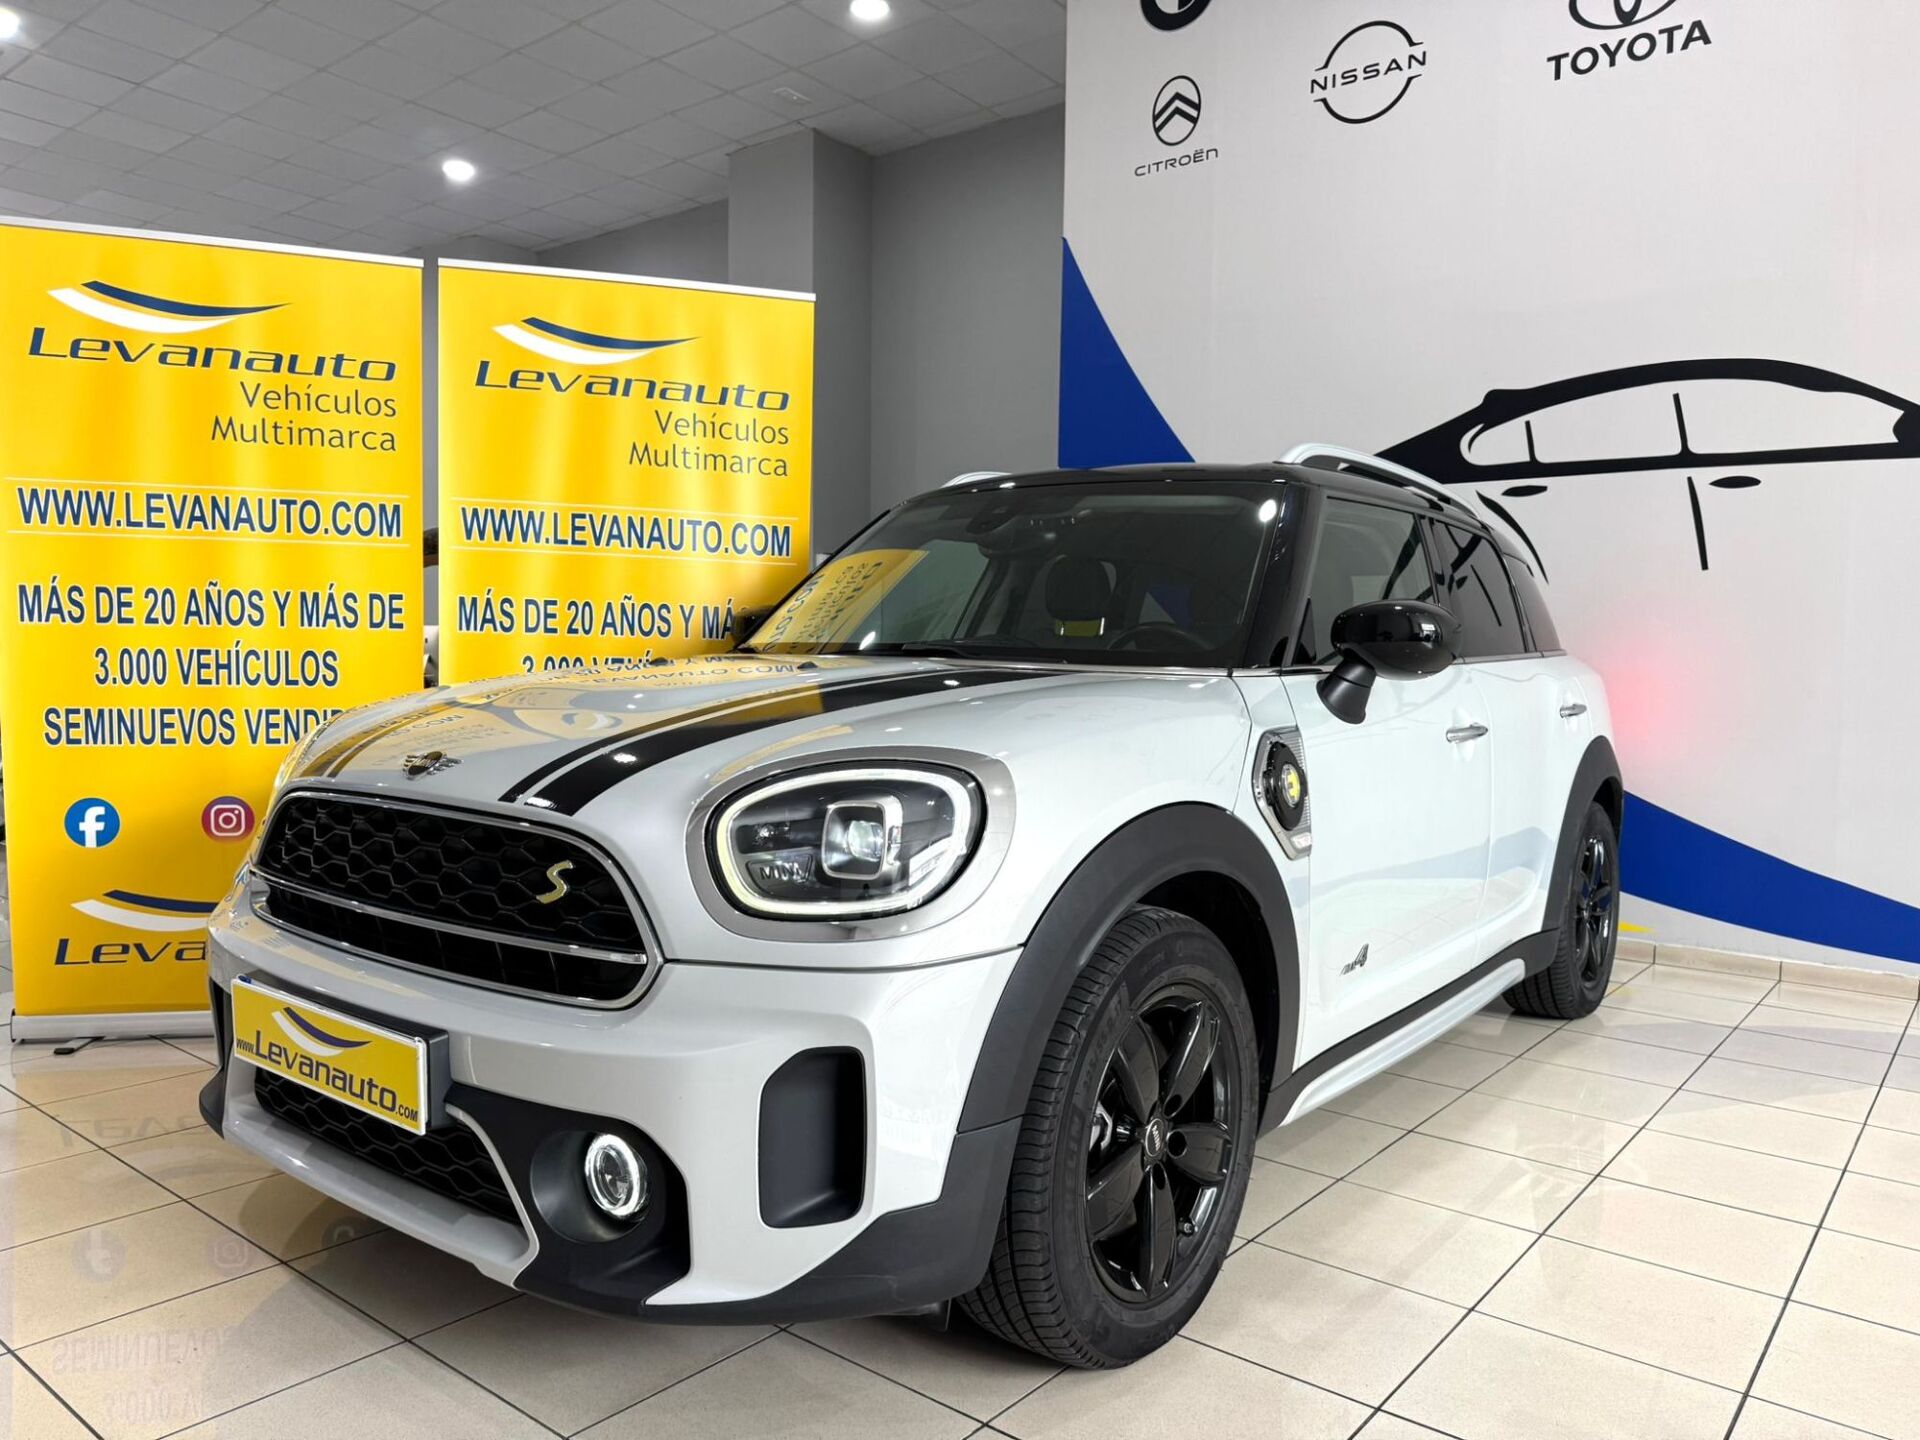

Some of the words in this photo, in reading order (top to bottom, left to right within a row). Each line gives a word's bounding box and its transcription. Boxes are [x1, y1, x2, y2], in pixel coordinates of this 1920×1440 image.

[1310, 50, 1427, 95] NISSAN
[1546, 18, 1712, 81] TOYOTA
[1134, 147, 1219, 177] CITROËN
[28, 327, 397, 381] Levanauto
[240, 381, 397, 418] Vehículos
[475, 360, 790, 411] Levanauto
[211, 415, 397, 452] Multimarca
[655, 410, 789, 445] Vehículos
[629, 441, 789, 477] Multimarca
[17, 487, 402, 538] WWW.LEVANAUTO.COM
[461, 507, 791, 556] WWW.LEVANAUTO.COM
[18, 575, 85, 624] MÁS
[95, 586, 134, 624] DE
[144, 587, 176, 625] 20
[184, 581, 264, 627] AÑOS
[272, 590, 292, 627] Y
[300, 583, 359, 629] MÁS
[369, 593, 404, 629] DE
[458, 588, 515, 633] MÁS
[524, 598, 558, 634] DE
[566, 600, 594, 635] 20
[600, 595, 672, 639] AÑOS
[679, 604, 695, 638] Y
[702, 598, 740, 640] MÁ
[94, 647, 168, 685] 3.000
[176, 640, 339, 687] VEHÍCULOS
[44, 707, 236, 746] SEMINUEVOS
[244, 708, 344, 745] VEND
